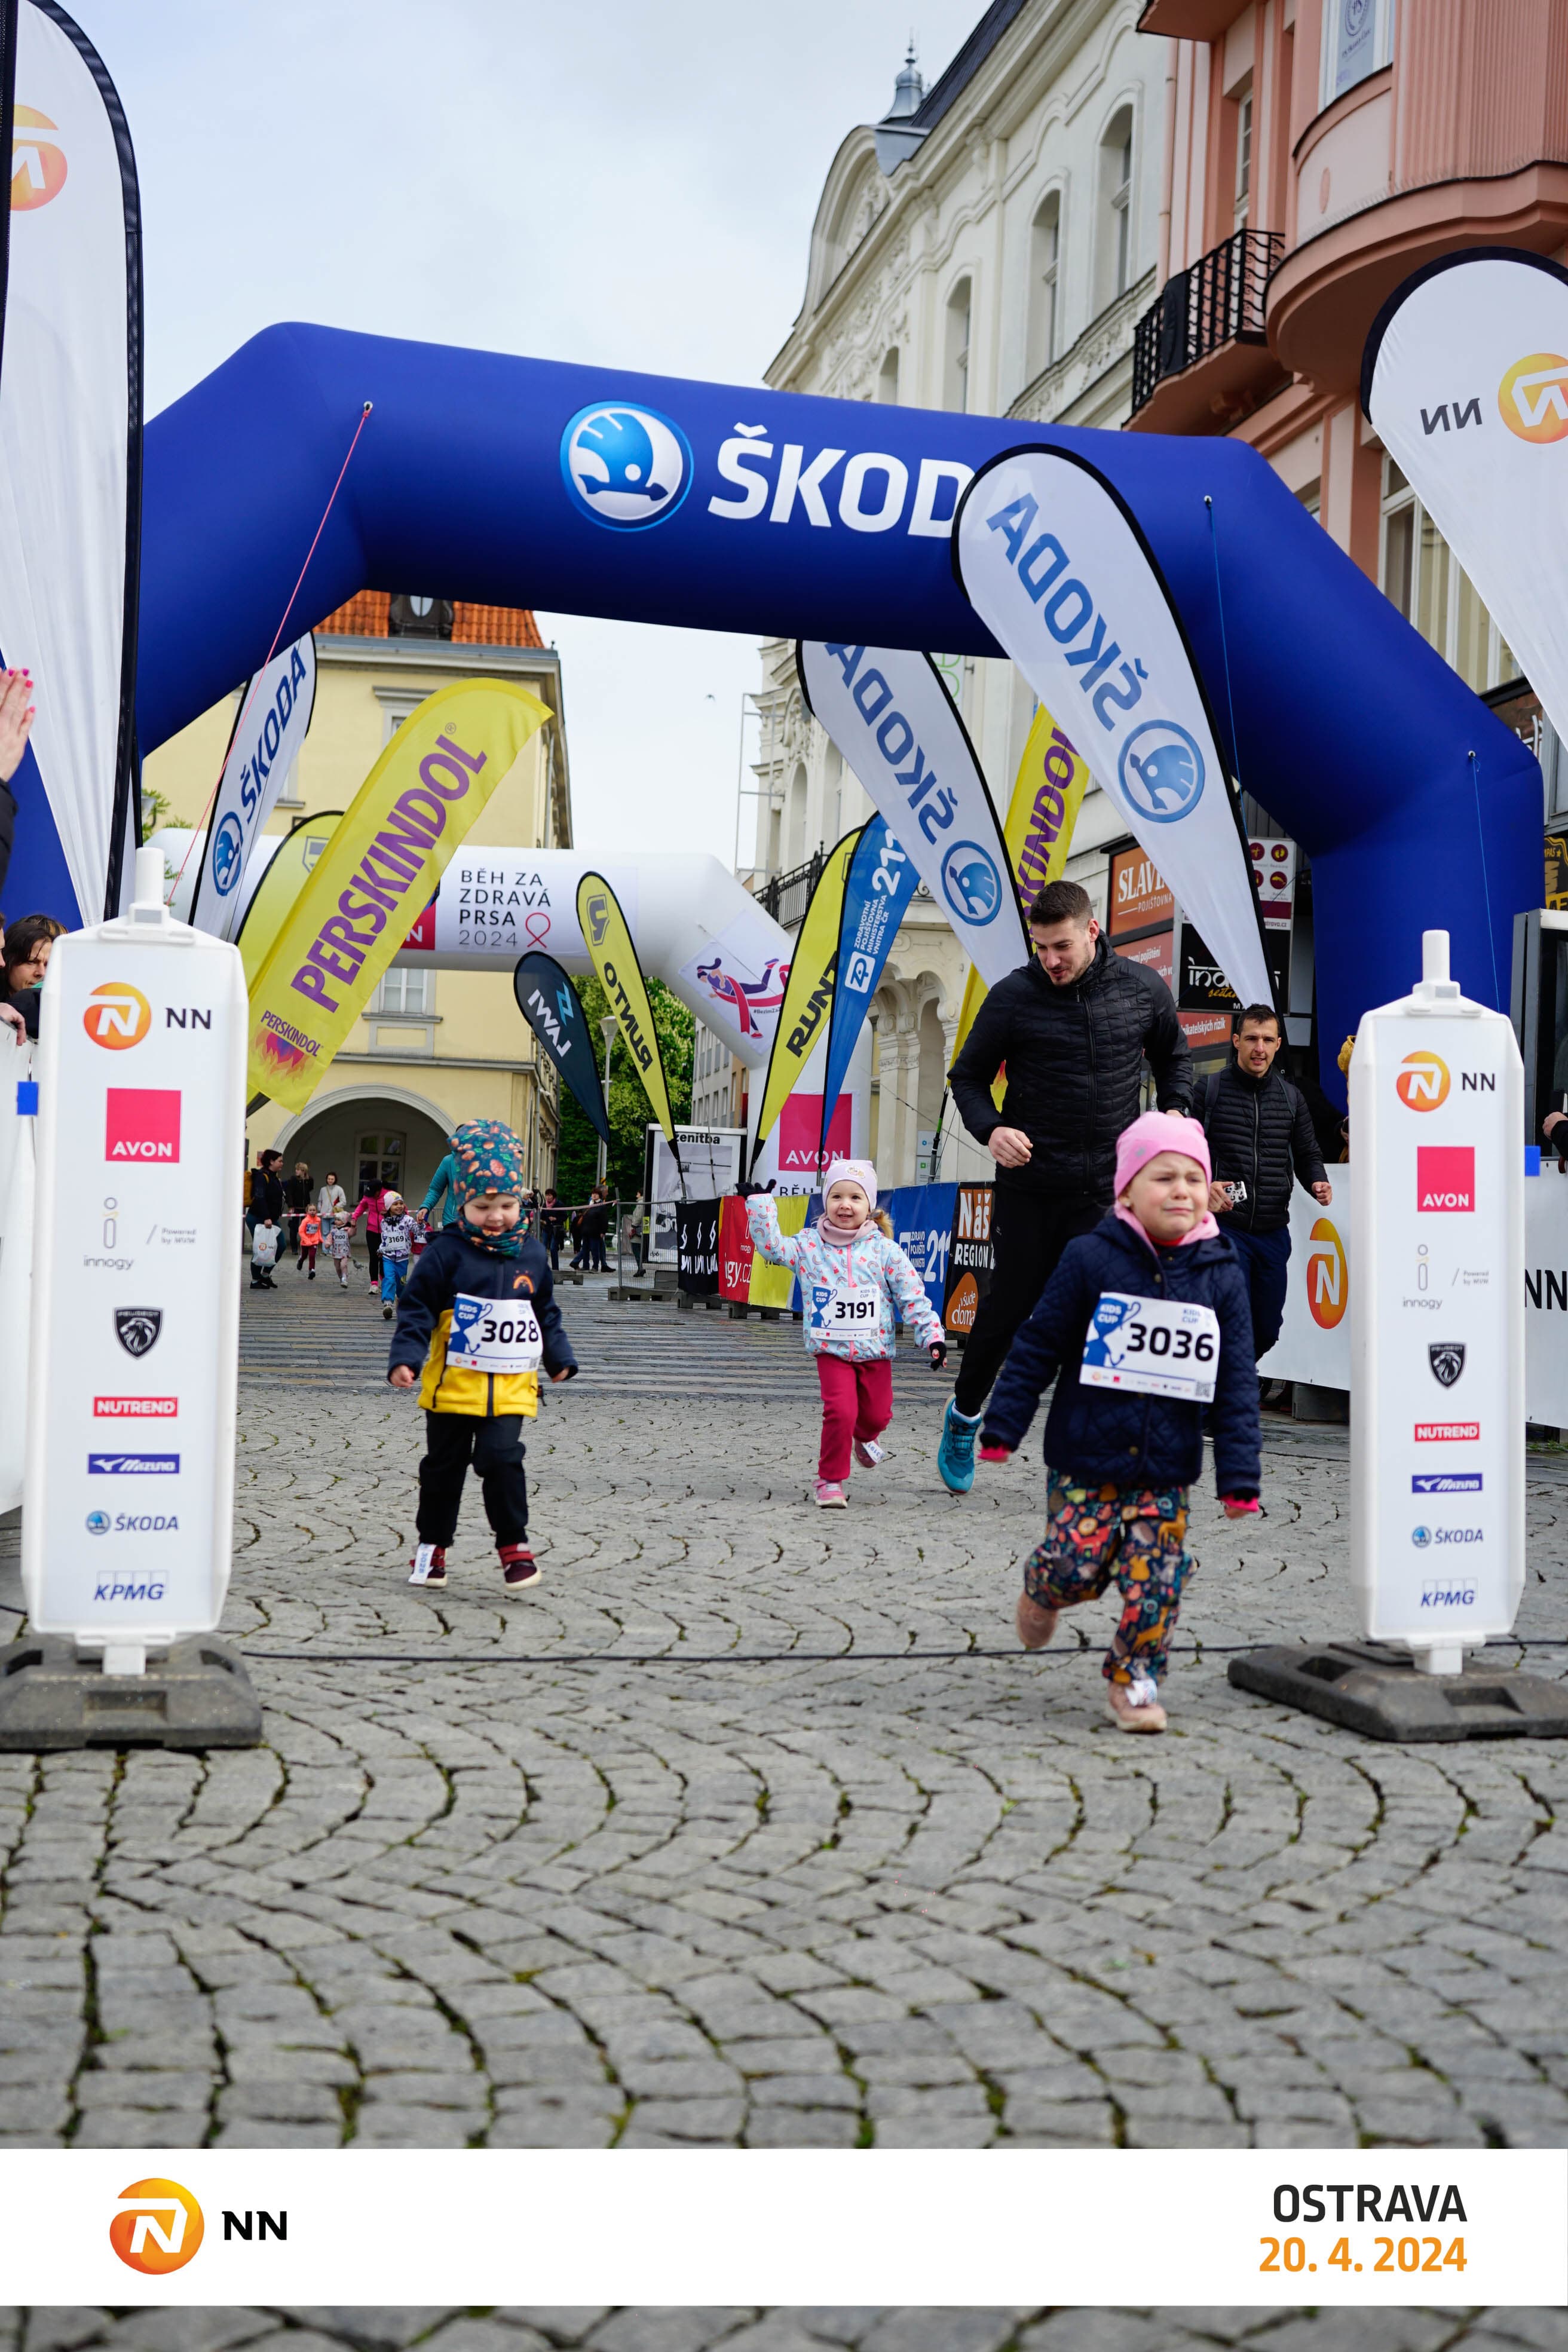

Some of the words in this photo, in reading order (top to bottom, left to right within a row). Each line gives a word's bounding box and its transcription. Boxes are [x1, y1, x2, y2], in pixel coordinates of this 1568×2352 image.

[708, 422, 976, 538] ŠKOD
[240, 645, 307, 825] ŠKODA
[461, 868, 504, 884] BĚH
[515, 872, 543, 886] ZA
[1118, 860, 1165, 904] SLAVI
[459, 888, 551, 907] ZDRAVÁ
[460, 909, 516, 926] PRSA
[854, 900, 872, 948] ZDRAVOTNÍ
[866, 895, 887, 953] MINISTERSTVA
[459, 929, 517, 947] 2024
[873, 926, 886, 955] VNITRA
[881, 911, 890, 924] ČR
[166, 1007, 211, 1030] NN
[261, 1009, 321, 1056] PERSKINDOL
[1461, 1072, 1495, 1091] NN
[112, 1141, 172, 1157] AVON
[785, 1150, 844, 1165] AVON
[1422, 1193, 1469, 1208] AVON
[958, 1192, 990, 1239] Náš
[84, 1255, 134, 1270] innogy
[954, 1243, 988, 1266] REGION
[960, 1291, 976, 1307] všude
[1525, 1269, 1567, 1311] NN
[458, 1304, 478, 1313] KIDS
[835, 1301, 874, 1319] 3191
[1100, 1304, 1122, 1315] KIDS
[1402, 1296, 1443, 1310] innogy
[1097, 1313, 1119, 1324] CUP
[481, 1319, 539, 1343] 3028
[1126, 1322, 1214, 1362] 3036
[97, 1399, 176, 1414] NUTREND
[1417, 1425, 1478, 1439] NUTREND
[115, 1513, 179, 1532] ŠKODA
[1434, 1527, 1483, 1544] ŠKODA
[94, 1583, 164, 1601] KPMG
[1421, 1590, 1475, 1607] KPMG
